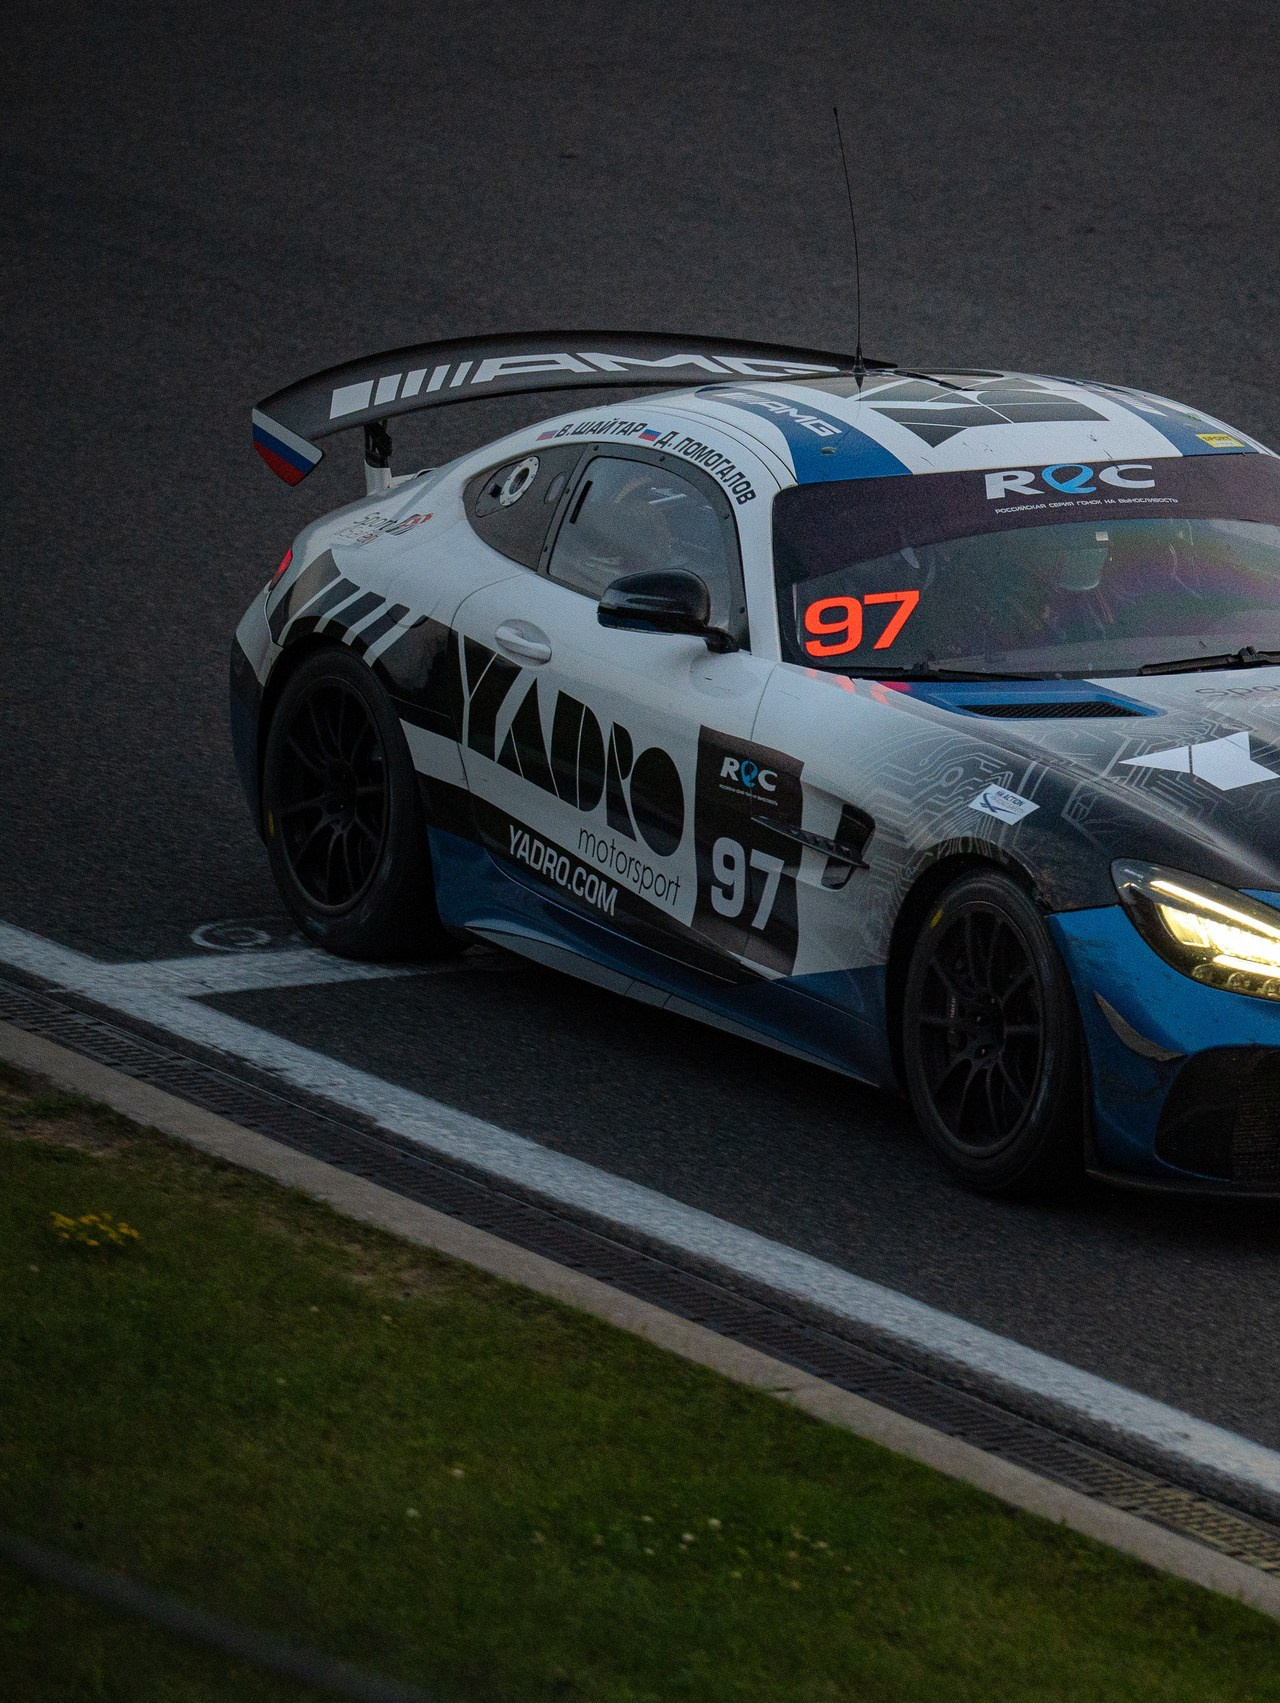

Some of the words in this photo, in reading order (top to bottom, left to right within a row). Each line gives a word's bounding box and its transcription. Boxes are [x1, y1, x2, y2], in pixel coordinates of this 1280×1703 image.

[678, 437, 758, 505] ПОМОГАЛОВ
[995, 503, 1047, 514] РОССИЙСКАЯ
[1049, 500, 1075, 509] СЕРИЯ
[804, 589, 921, 657] 97
[463, 635, 685, 857] YADRO
[509, 824, 619, 916] YADRO.COM
[578, 827, 681, 905] motorsport
[711, 836, 785, 931] 97
